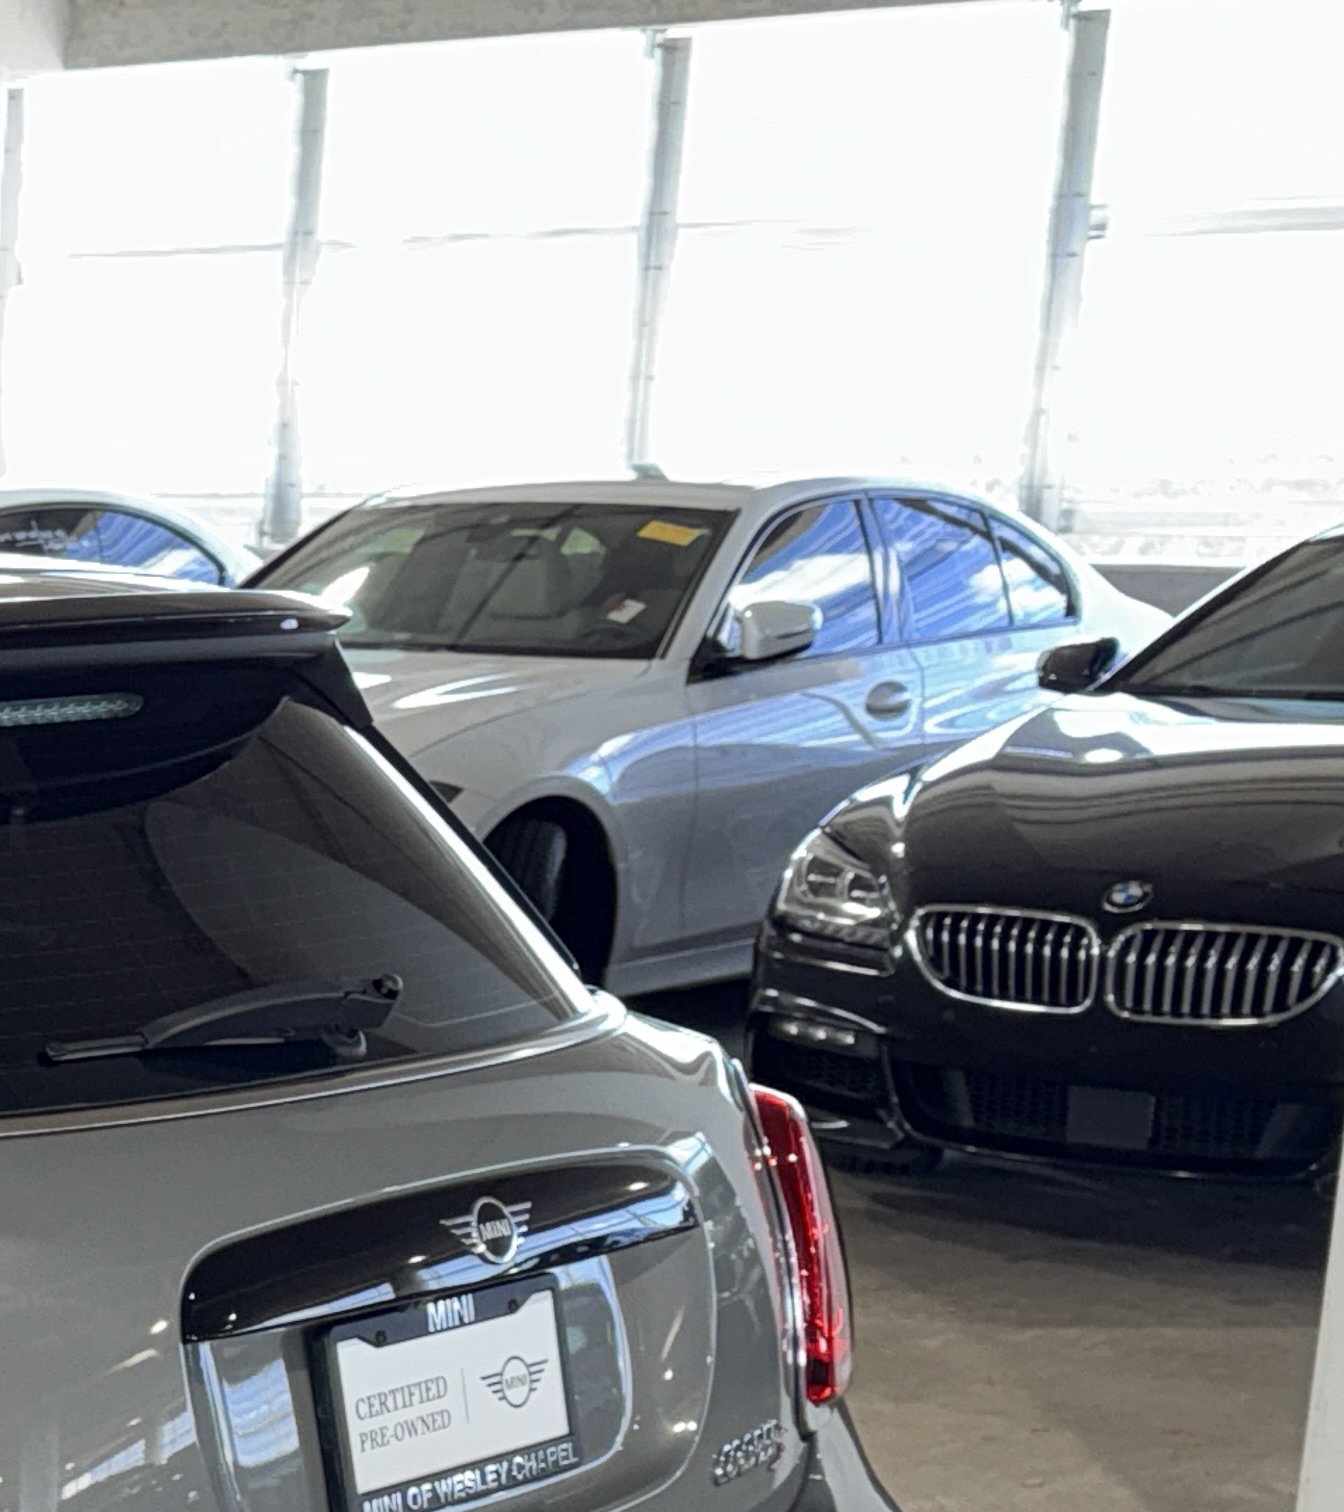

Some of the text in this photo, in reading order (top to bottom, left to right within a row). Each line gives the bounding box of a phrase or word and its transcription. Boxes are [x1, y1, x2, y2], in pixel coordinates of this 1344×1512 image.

[479, 1218, 512, 1242] MINI
[426, 1293, 476, 1332] MINI
[355, 1375, 449, 1421] CERTIFIED
[359, 1408, 452, 1453] PRE-OWNED
[407, 1483, 433, 1511] OF
[435, 1460, 509, 1503] WESLEY
[511, 1441, 580, 1480] CHAPEL
